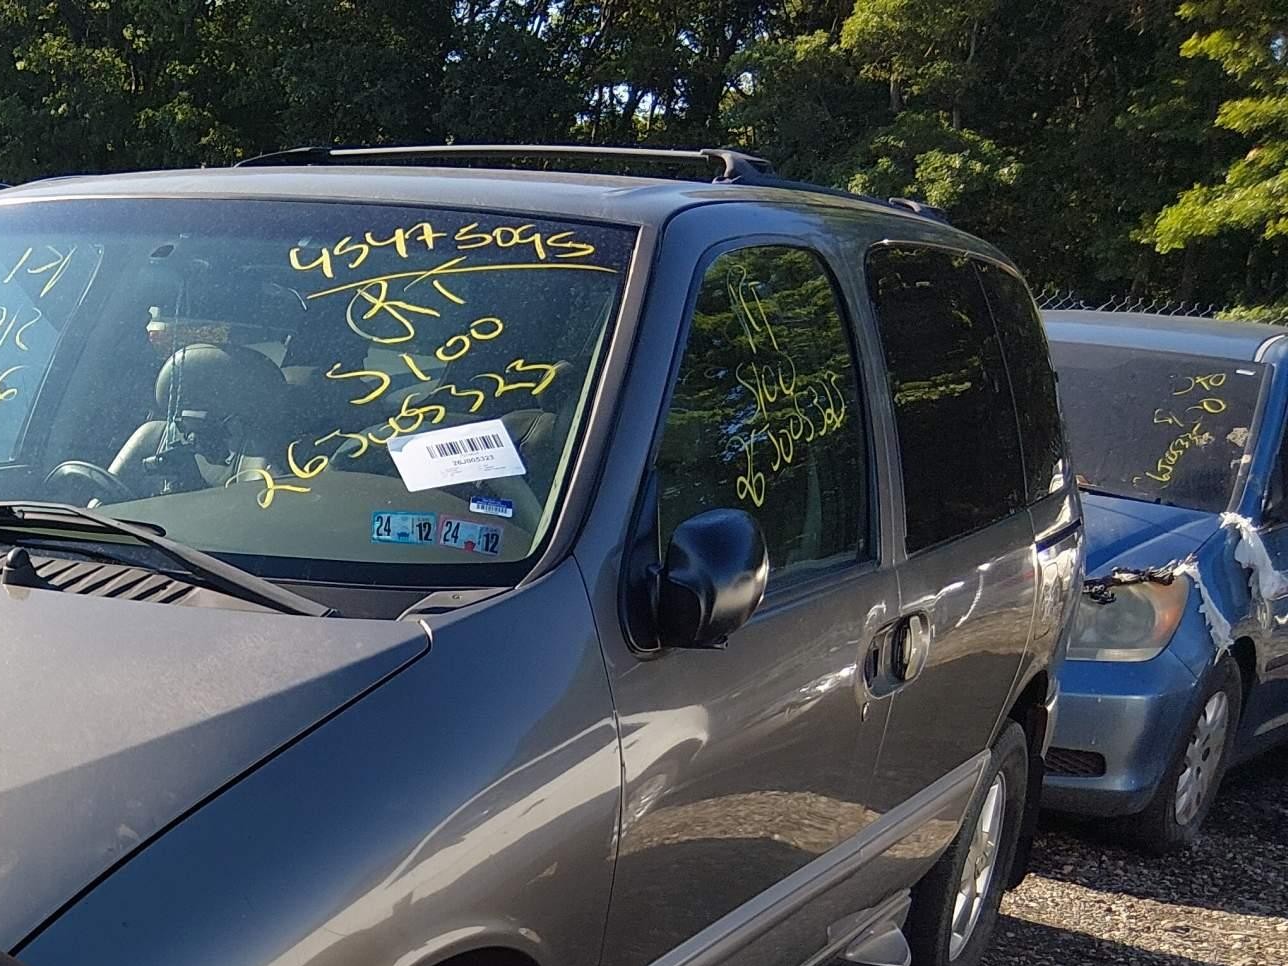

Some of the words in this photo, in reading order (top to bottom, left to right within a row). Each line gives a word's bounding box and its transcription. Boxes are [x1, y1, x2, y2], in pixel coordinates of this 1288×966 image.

[289, 223, 595, 279] 45475095
[326, 317, 504, 404] S100
[376, 516, 392, 537] 24
[416, 522, 433, 542] 12
[443, 521, 461, 543] 24
[483, 533, 500, 554] 12
